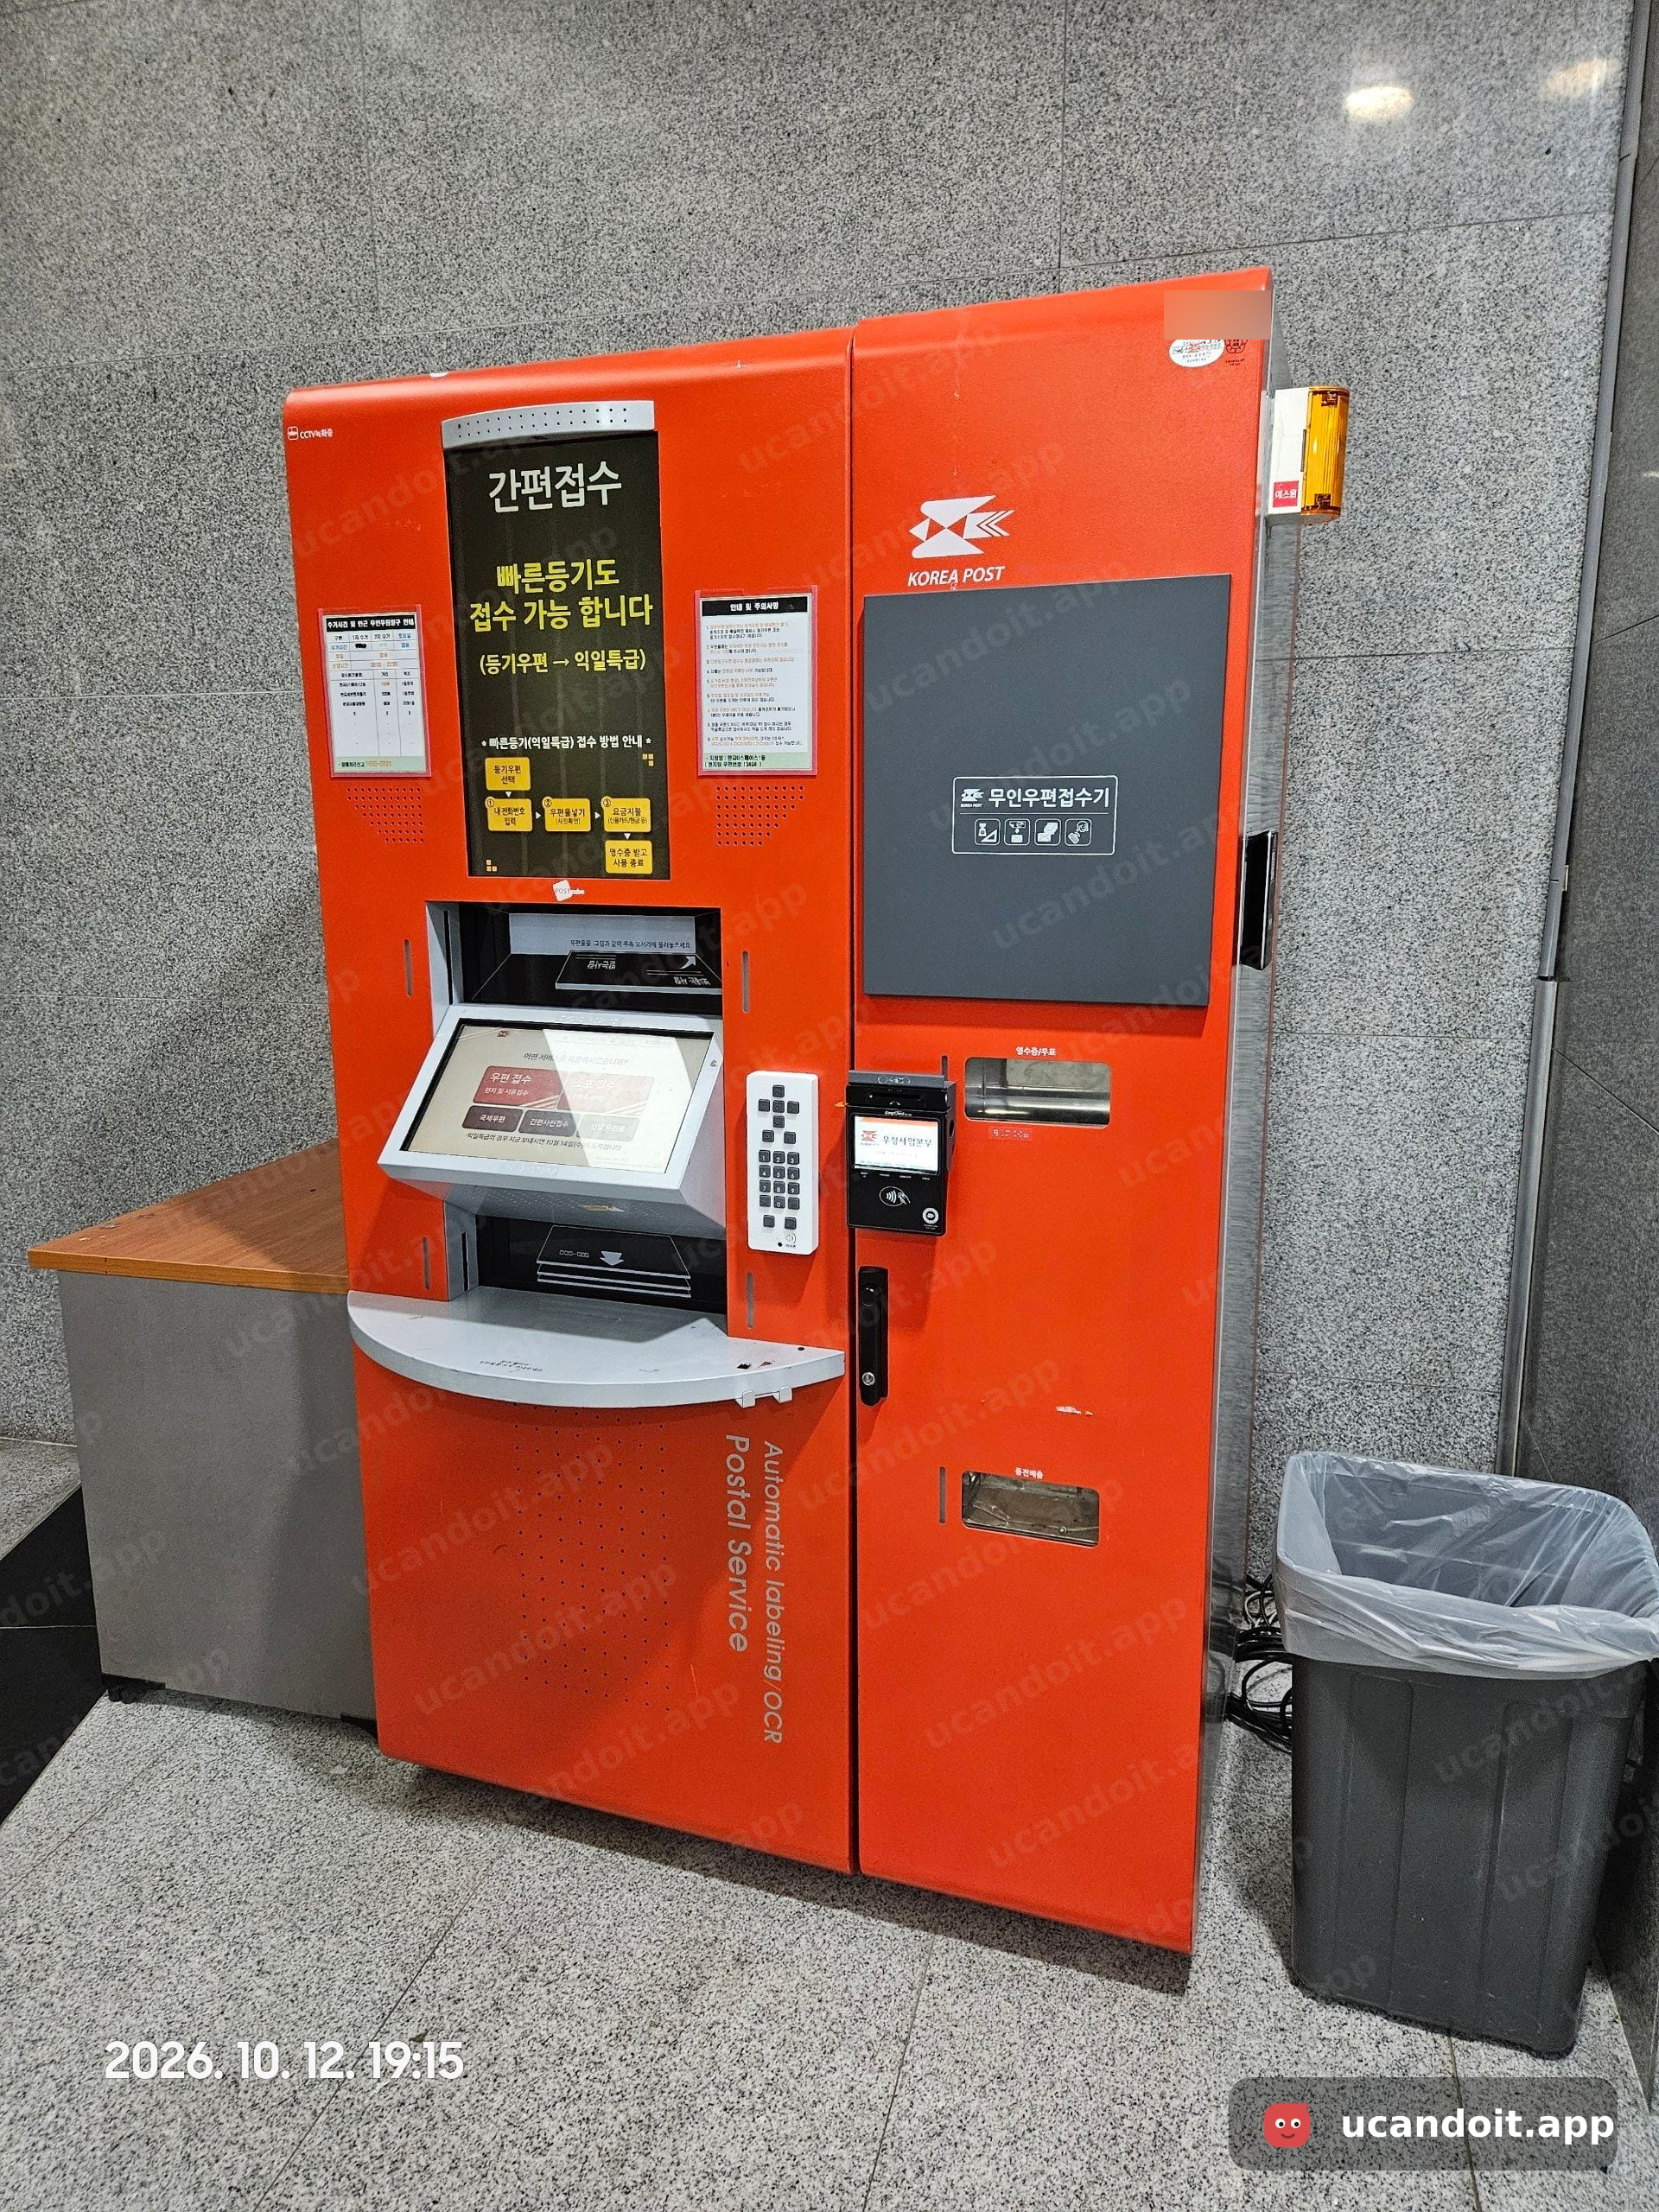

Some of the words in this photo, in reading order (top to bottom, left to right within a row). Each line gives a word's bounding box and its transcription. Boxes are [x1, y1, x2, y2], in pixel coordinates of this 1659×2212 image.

[488, 461, 622, 512] 간편접수
[496, 559, 619, 594] 빠른등기도
[907, 569, 958, 586] KOREA
[963, 566, 1006, 582] POST
[754, 601, 779, 610] 주의사항
[470, 601, 516, 632] 접수
[524, 599, 571, 629] 가능
[579, 594, 653, 628] 합니다
[480, 652, 548, 675] (등기우편
[575, 649, 646, 671] 익일특급)
[489, 736, 575, 750] 빠른등기(익일특급)
[577, 737, 597, 748] 접수
[599, 735, 619, 748] 방법
[622, 735, 643, 748] 안내
[493, 765, 521, 774] 등기우편
[501, 775, 515, 785] 선택
[988, 787, 1109, 808] 무인우편접수기
[613, 807, 642, 817] 요금지불
[505, 817, 516, 826] 입력
[609, 849, 631, 857] 영수증
[630, 858, 644, 867] 종료
[1016, 1046, 1057, 1056] 영수증/우표
[490, 1072, 510, 1083] 우편
[512, 1073, 531, 1084] 접수
[480, 1114, 505, 1123] 국제우편
[884, 1135, 931, 1147] 우정사업본부
[726, 1434, 751, 1529] Postal
[764, 1440, 785, 1572] Automatic
[728, 1540, 753, 1652] Service
[764, 1580, 785, 1744] labeling/OCR
